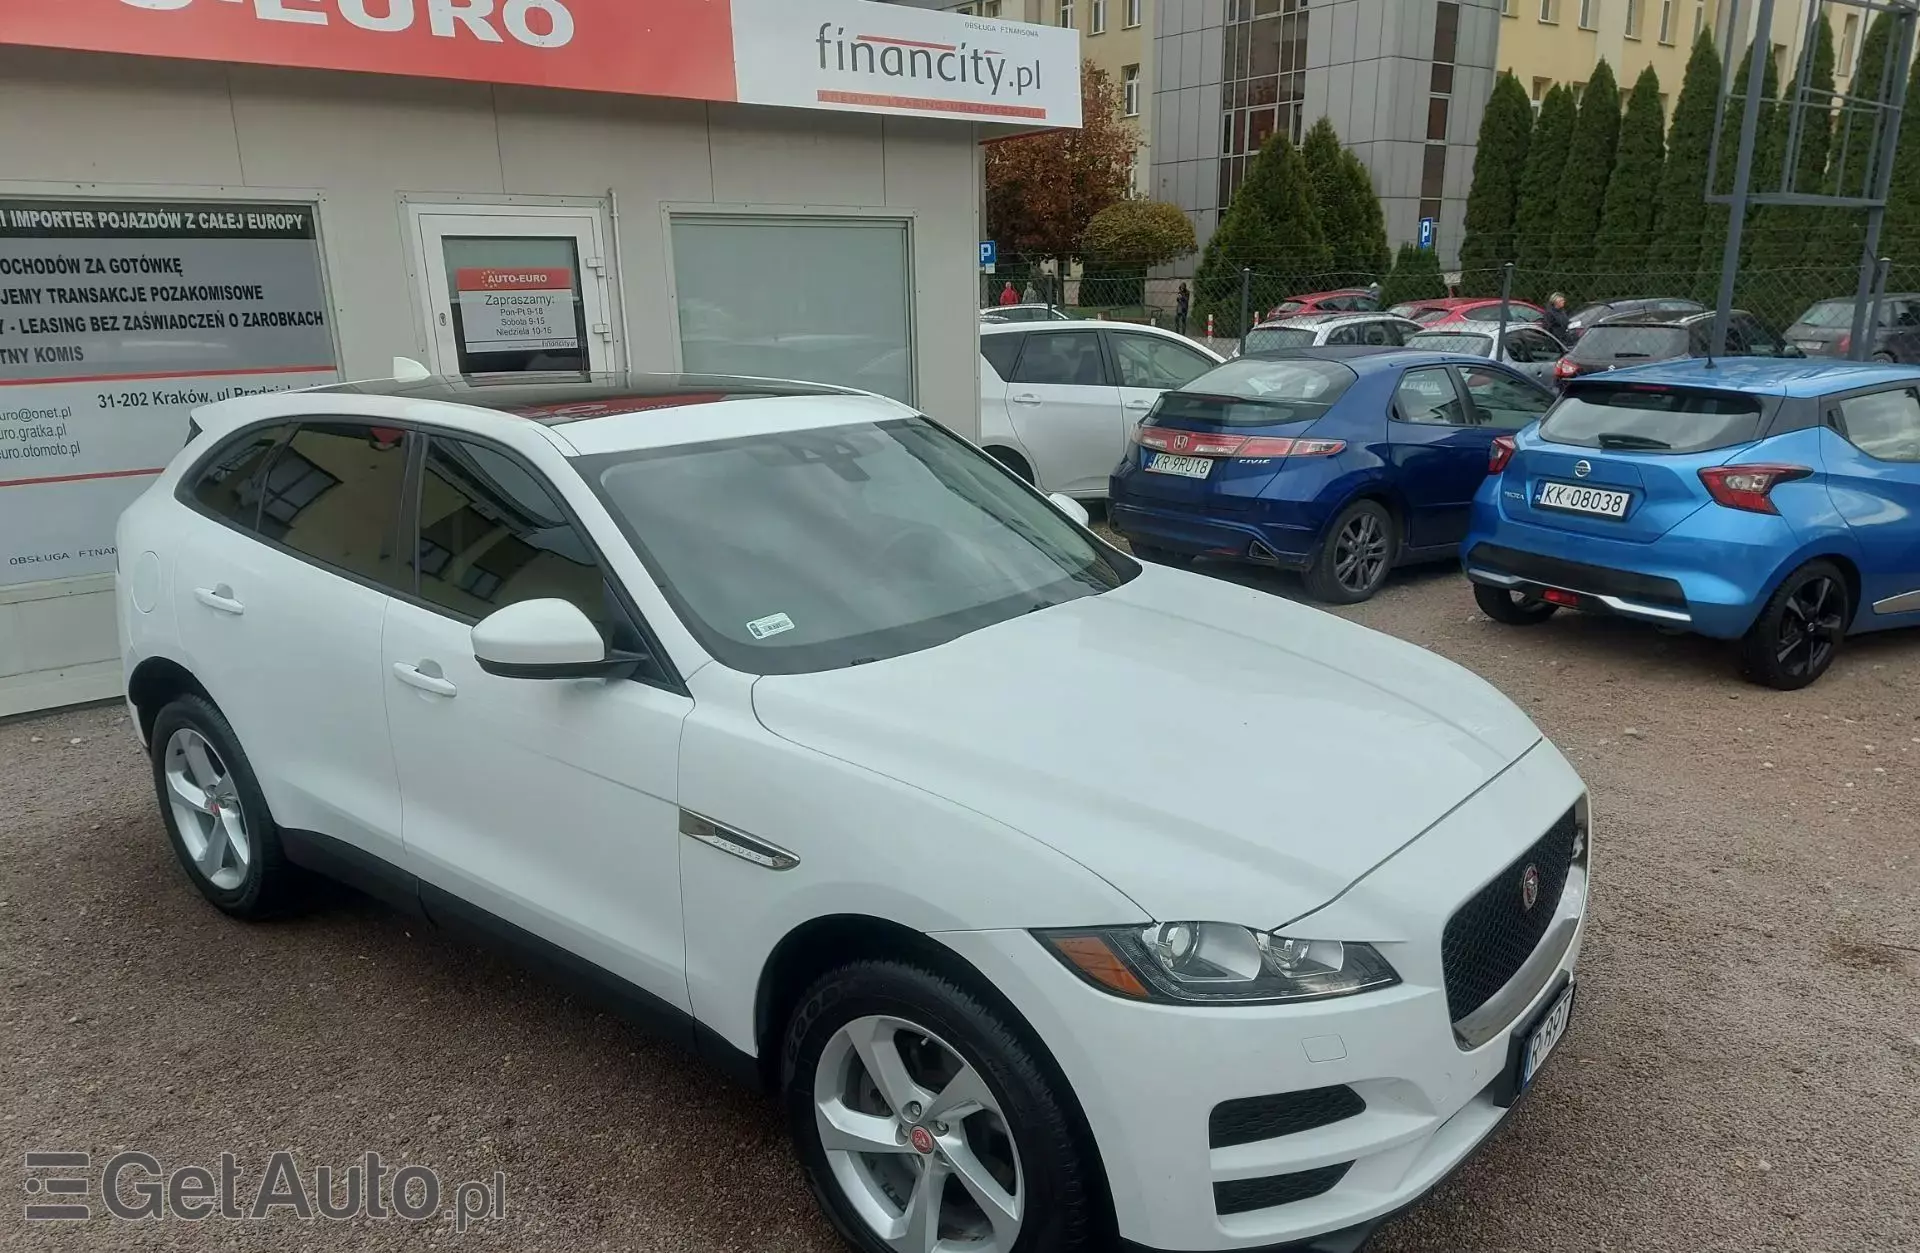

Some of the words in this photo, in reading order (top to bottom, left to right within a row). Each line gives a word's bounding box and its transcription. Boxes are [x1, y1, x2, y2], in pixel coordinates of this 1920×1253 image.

[816, 22, 1041, 95] financity.pl
[10, 210, 95, 228] IMPORTER
[98, 208, 181, 229] POJAZDÓW
[185, 213, 195, 229] Z
[199, 212, 244, 229] CAŁEJ
[248, 213, 303, 230] EUROPY
[85, 258, 106, 274] ZA
[109, 254, 183, 277] GOTÓWKĘ
[488, 274, 547, 284] AUTO-EURO
[46, 287, 147, 304] TRANSAKCJE
[150, 285, 264, 303] POZAKOMISOWE
[485, 293, 555, 308] Zapraszamy:
[19, 317, 86, 334] LEASING
[90, 315, 120, 332] BEZ
[123, 310, 225, 331] ZAŚWIADCZEŃ
[229, 313, 239, 328] O
[242, 311, 324, 328] ZAROBKACH
[34, 345, 84, 363] KOMIS
[98, 391, 149, 408] 31-202
[152, 388, 213, 405] Kraków,
[0, 441, 81, 459] uro.otomoto.pl
[1154, 454, 1171, 471] KR
[1173, 456, 1209, 474] 9RU18
[1545, 485, 1568, 505] KK
[1570, 489, 1623, 513] 08038
[9, 552, 71, 566] OBSŁUGA
